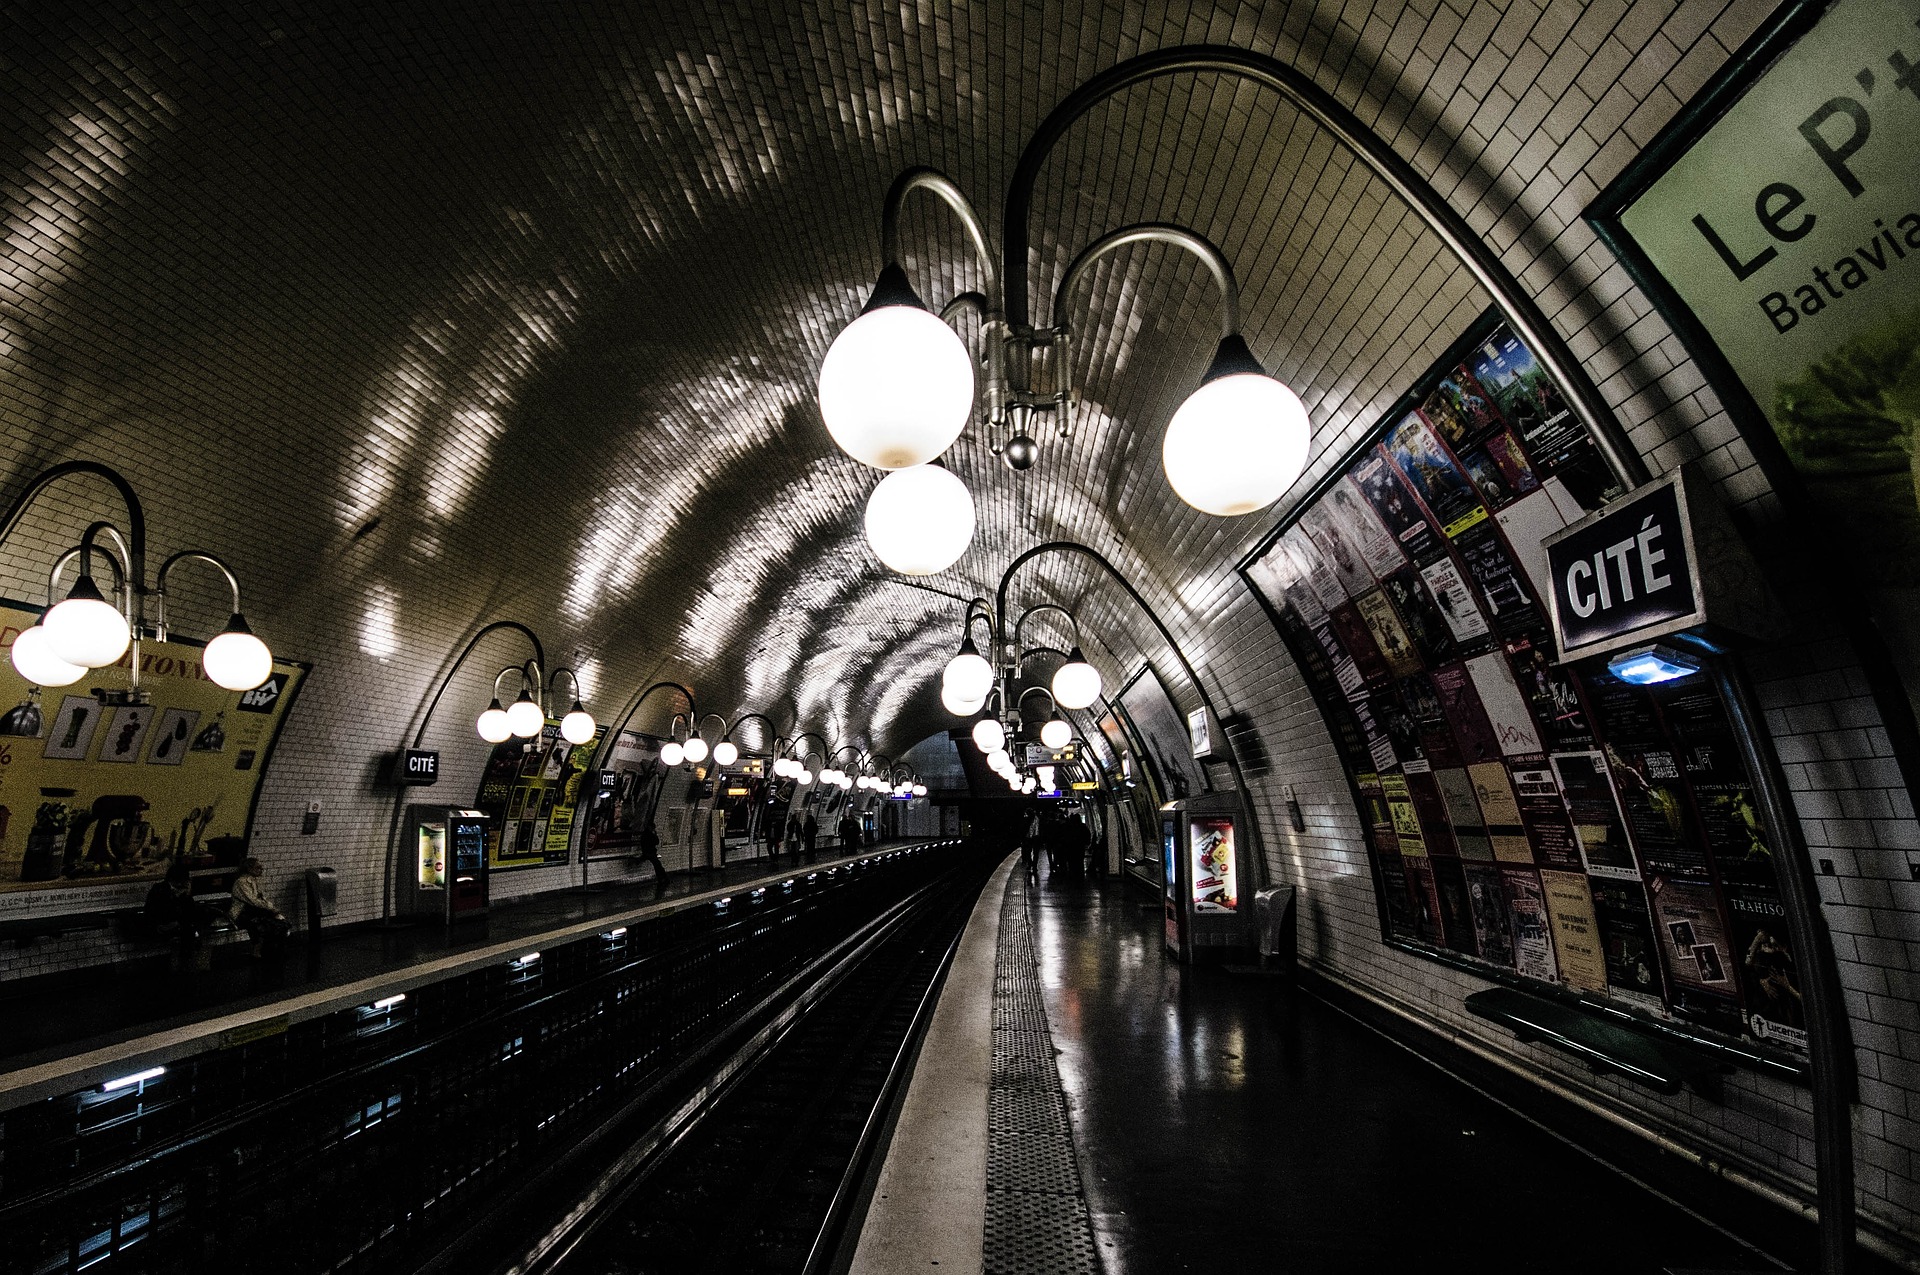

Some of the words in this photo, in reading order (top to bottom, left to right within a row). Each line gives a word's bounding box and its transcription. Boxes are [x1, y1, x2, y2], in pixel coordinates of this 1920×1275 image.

[1692, 182, 1816, 282] Le
[1567, 513, 1671, 619] CITÉ
[409, 755, 435, 774] CITÉ
[602, 772, 615, 787] CITÉ
